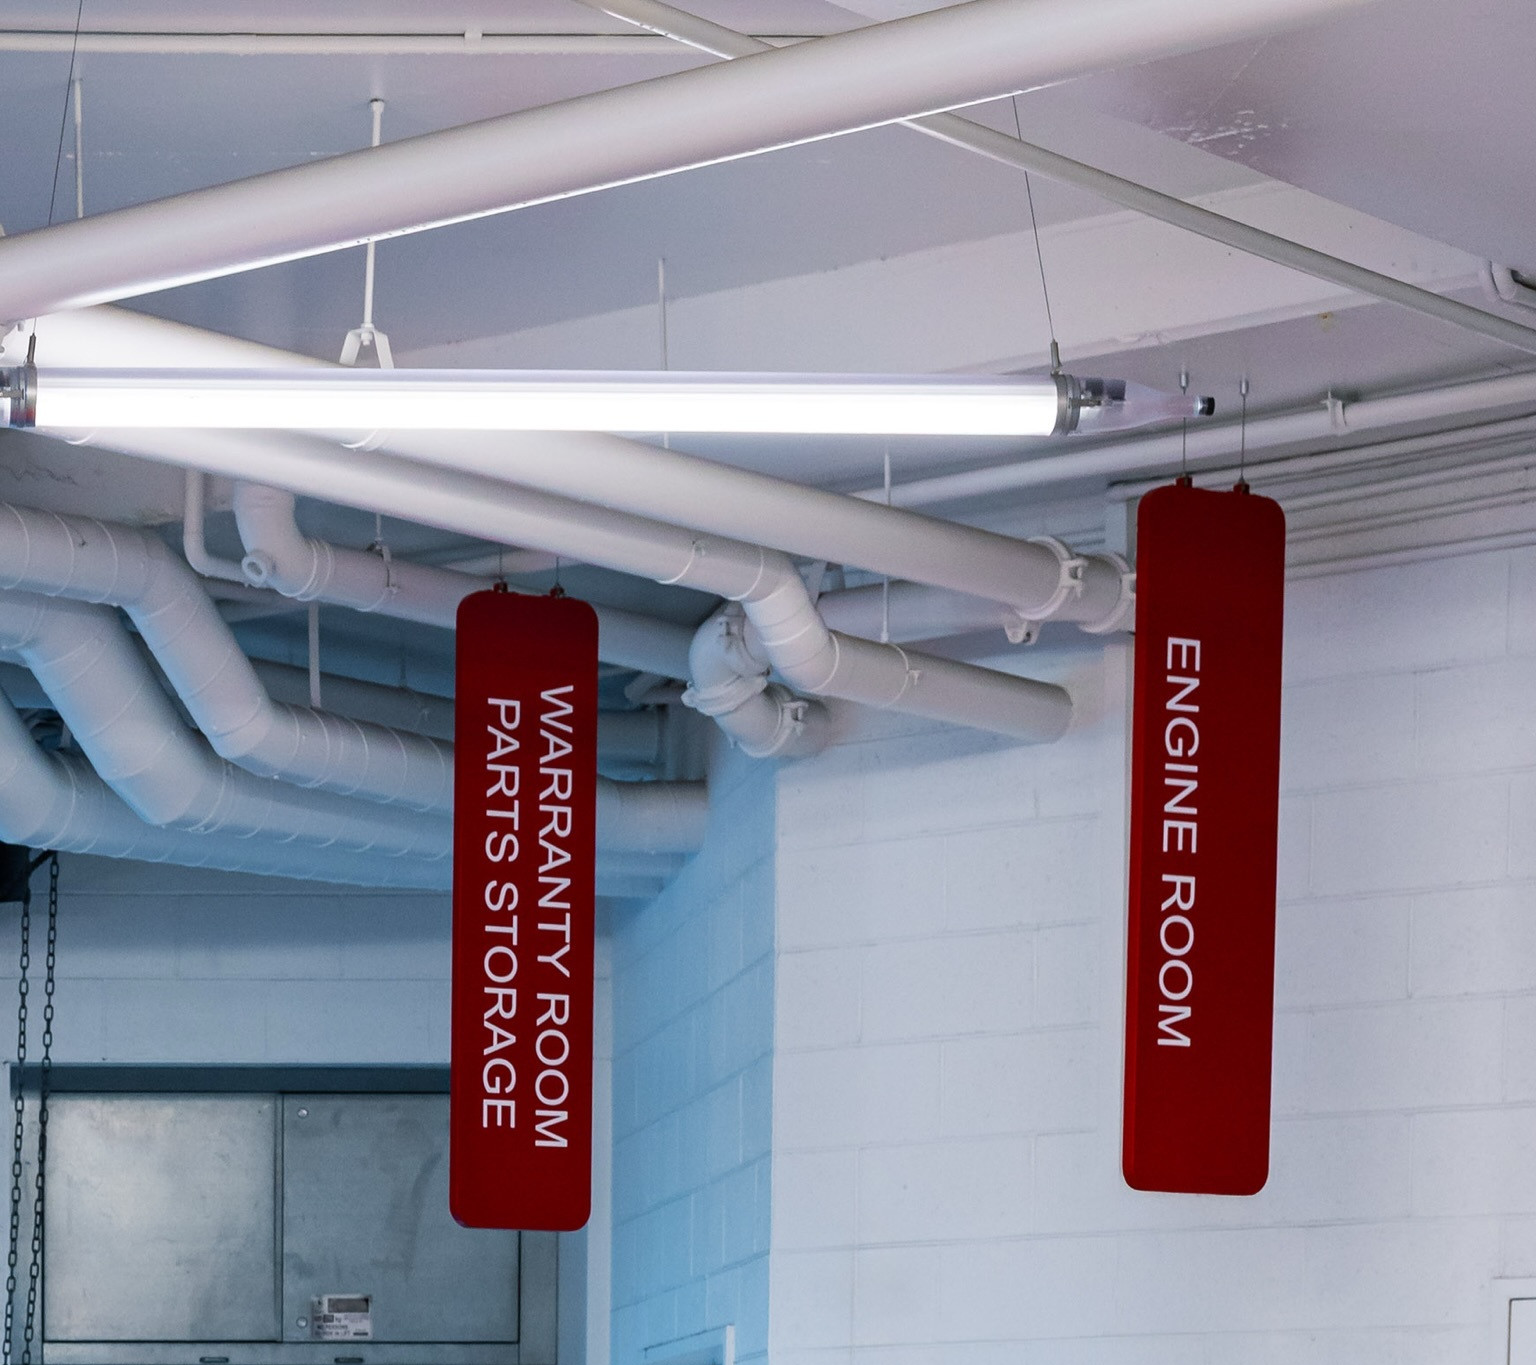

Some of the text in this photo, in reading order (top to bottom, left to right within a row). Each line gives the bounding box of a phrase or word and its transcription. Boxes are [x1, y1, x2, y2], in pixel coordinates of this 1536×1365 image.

[482, 697, 521, 1129] PARTS STORAGE
[534, 684, 574, 1148] WARRANTY ROOM
[1156, 636, 1201, 1048] ENGINE ROOM
